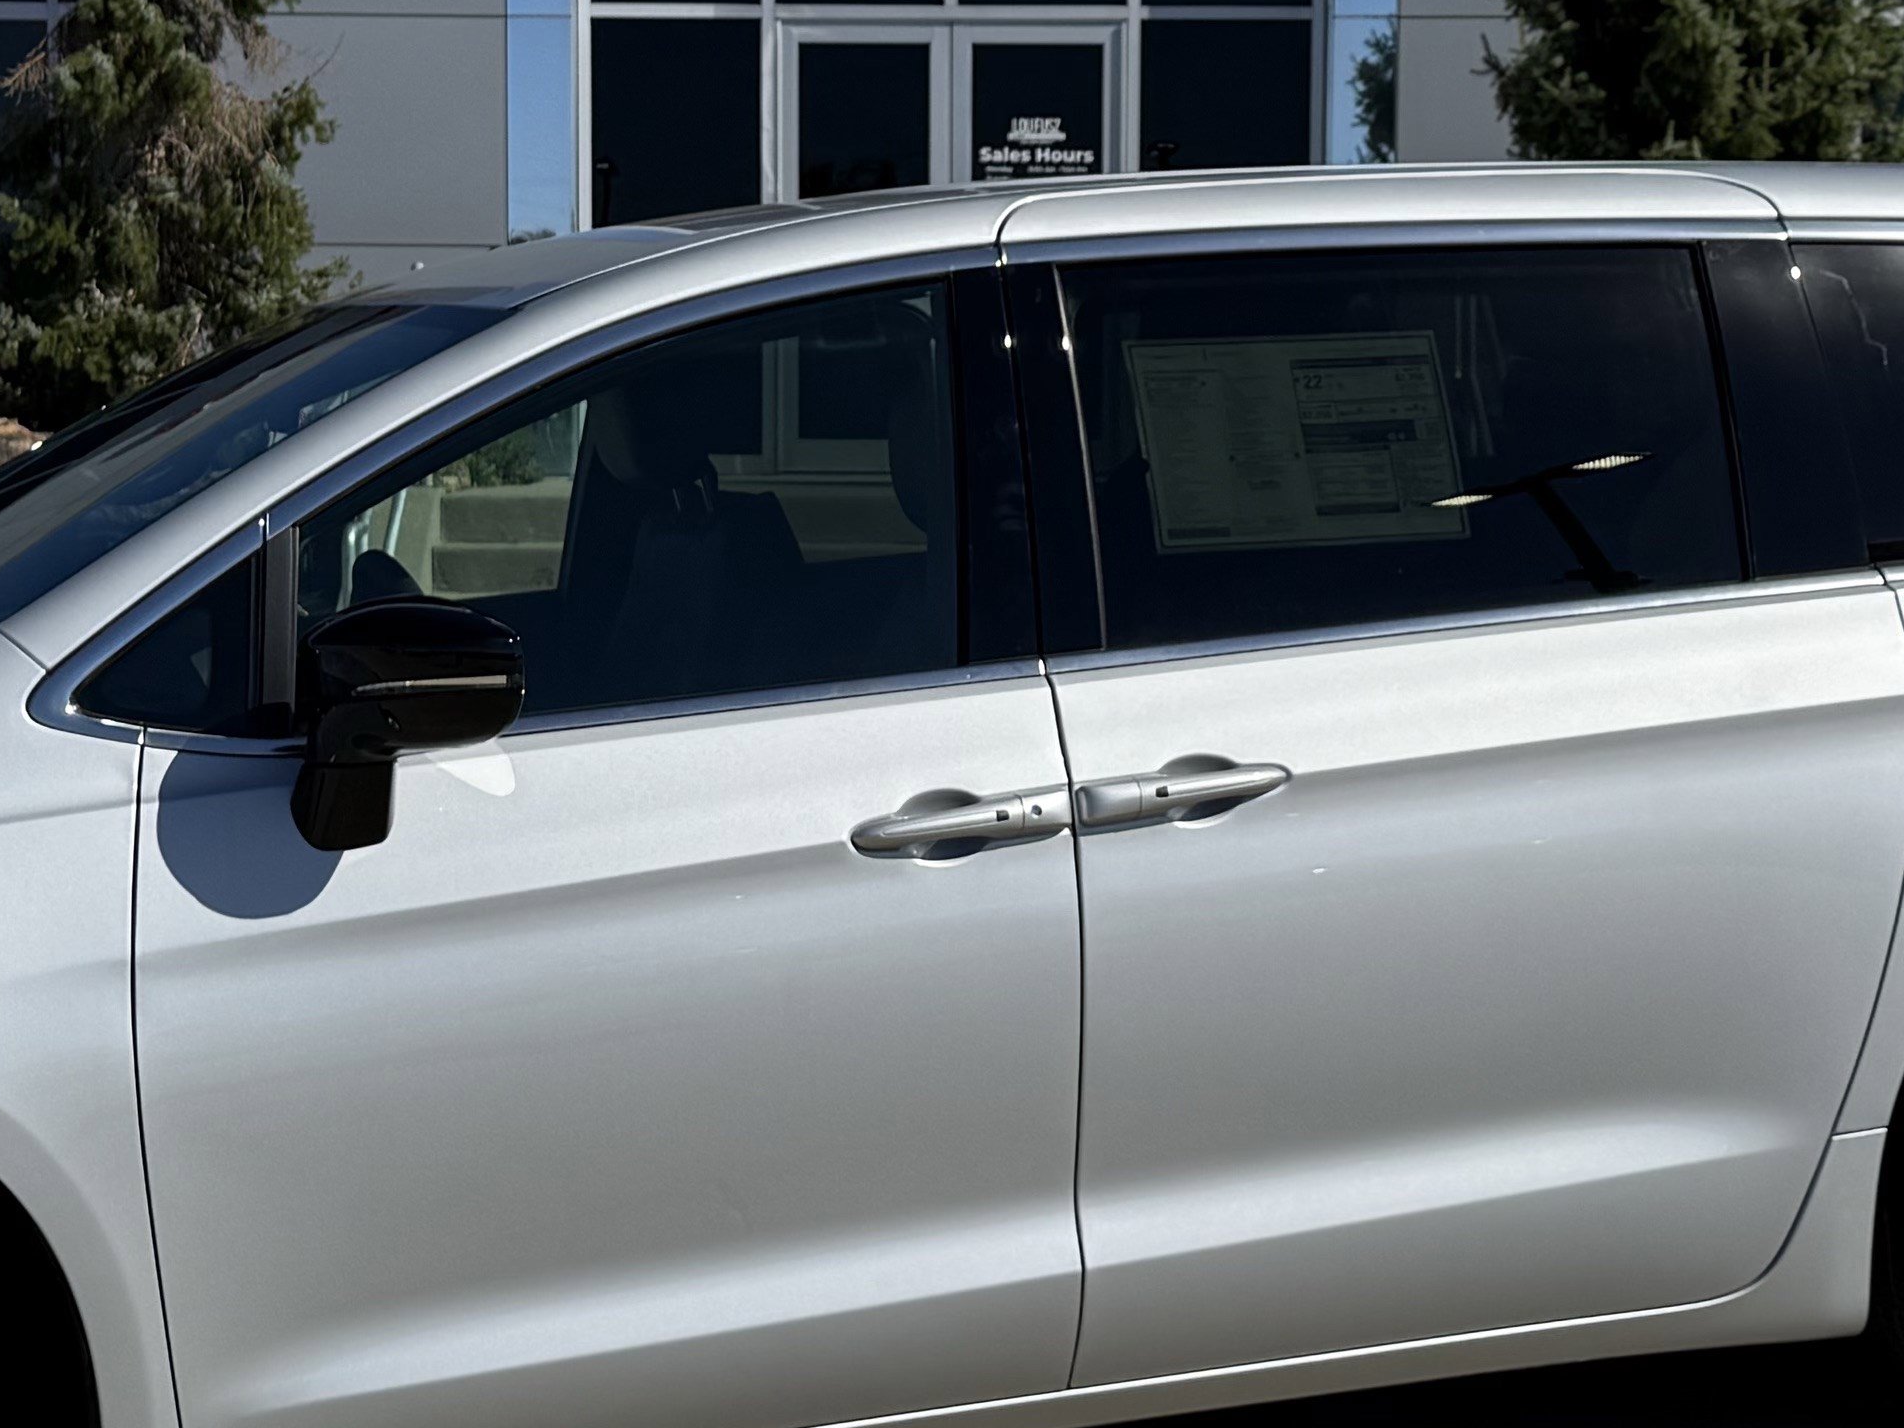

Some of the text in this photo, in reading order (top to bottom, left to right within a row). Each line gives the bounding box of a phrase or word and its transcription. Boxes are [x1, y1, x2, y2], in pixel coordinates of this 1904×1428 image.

[979, 147, 1094, 163] Sales Hours
[1302, 375, 1324, 391] 22
